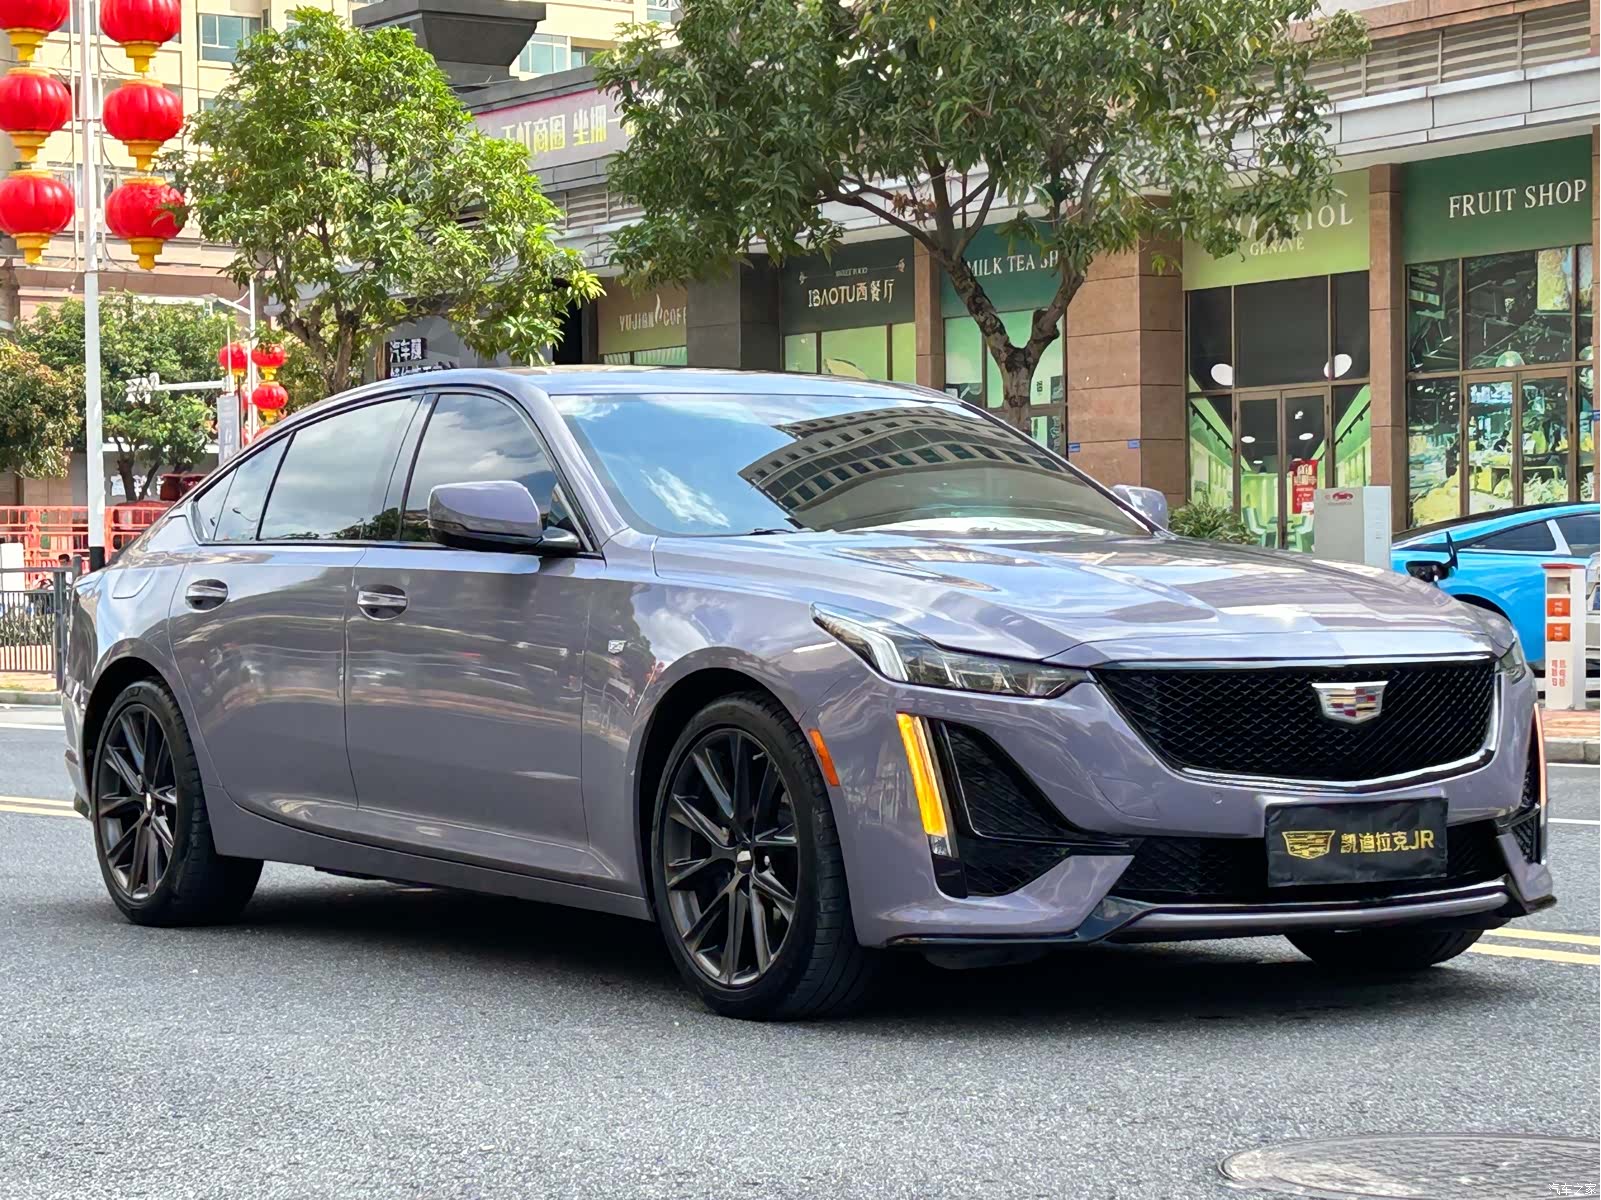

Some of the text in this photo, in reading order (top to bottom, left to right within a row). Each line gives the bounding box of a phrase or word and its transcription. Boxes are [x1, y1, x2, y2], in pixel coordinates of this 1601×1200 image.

[1449, 179, 1587, 218] FRUIT SHOP
[1007, 254, 1036, 273] TEA
[1340, 829, 1435, 854] 凯迪拉克JR
